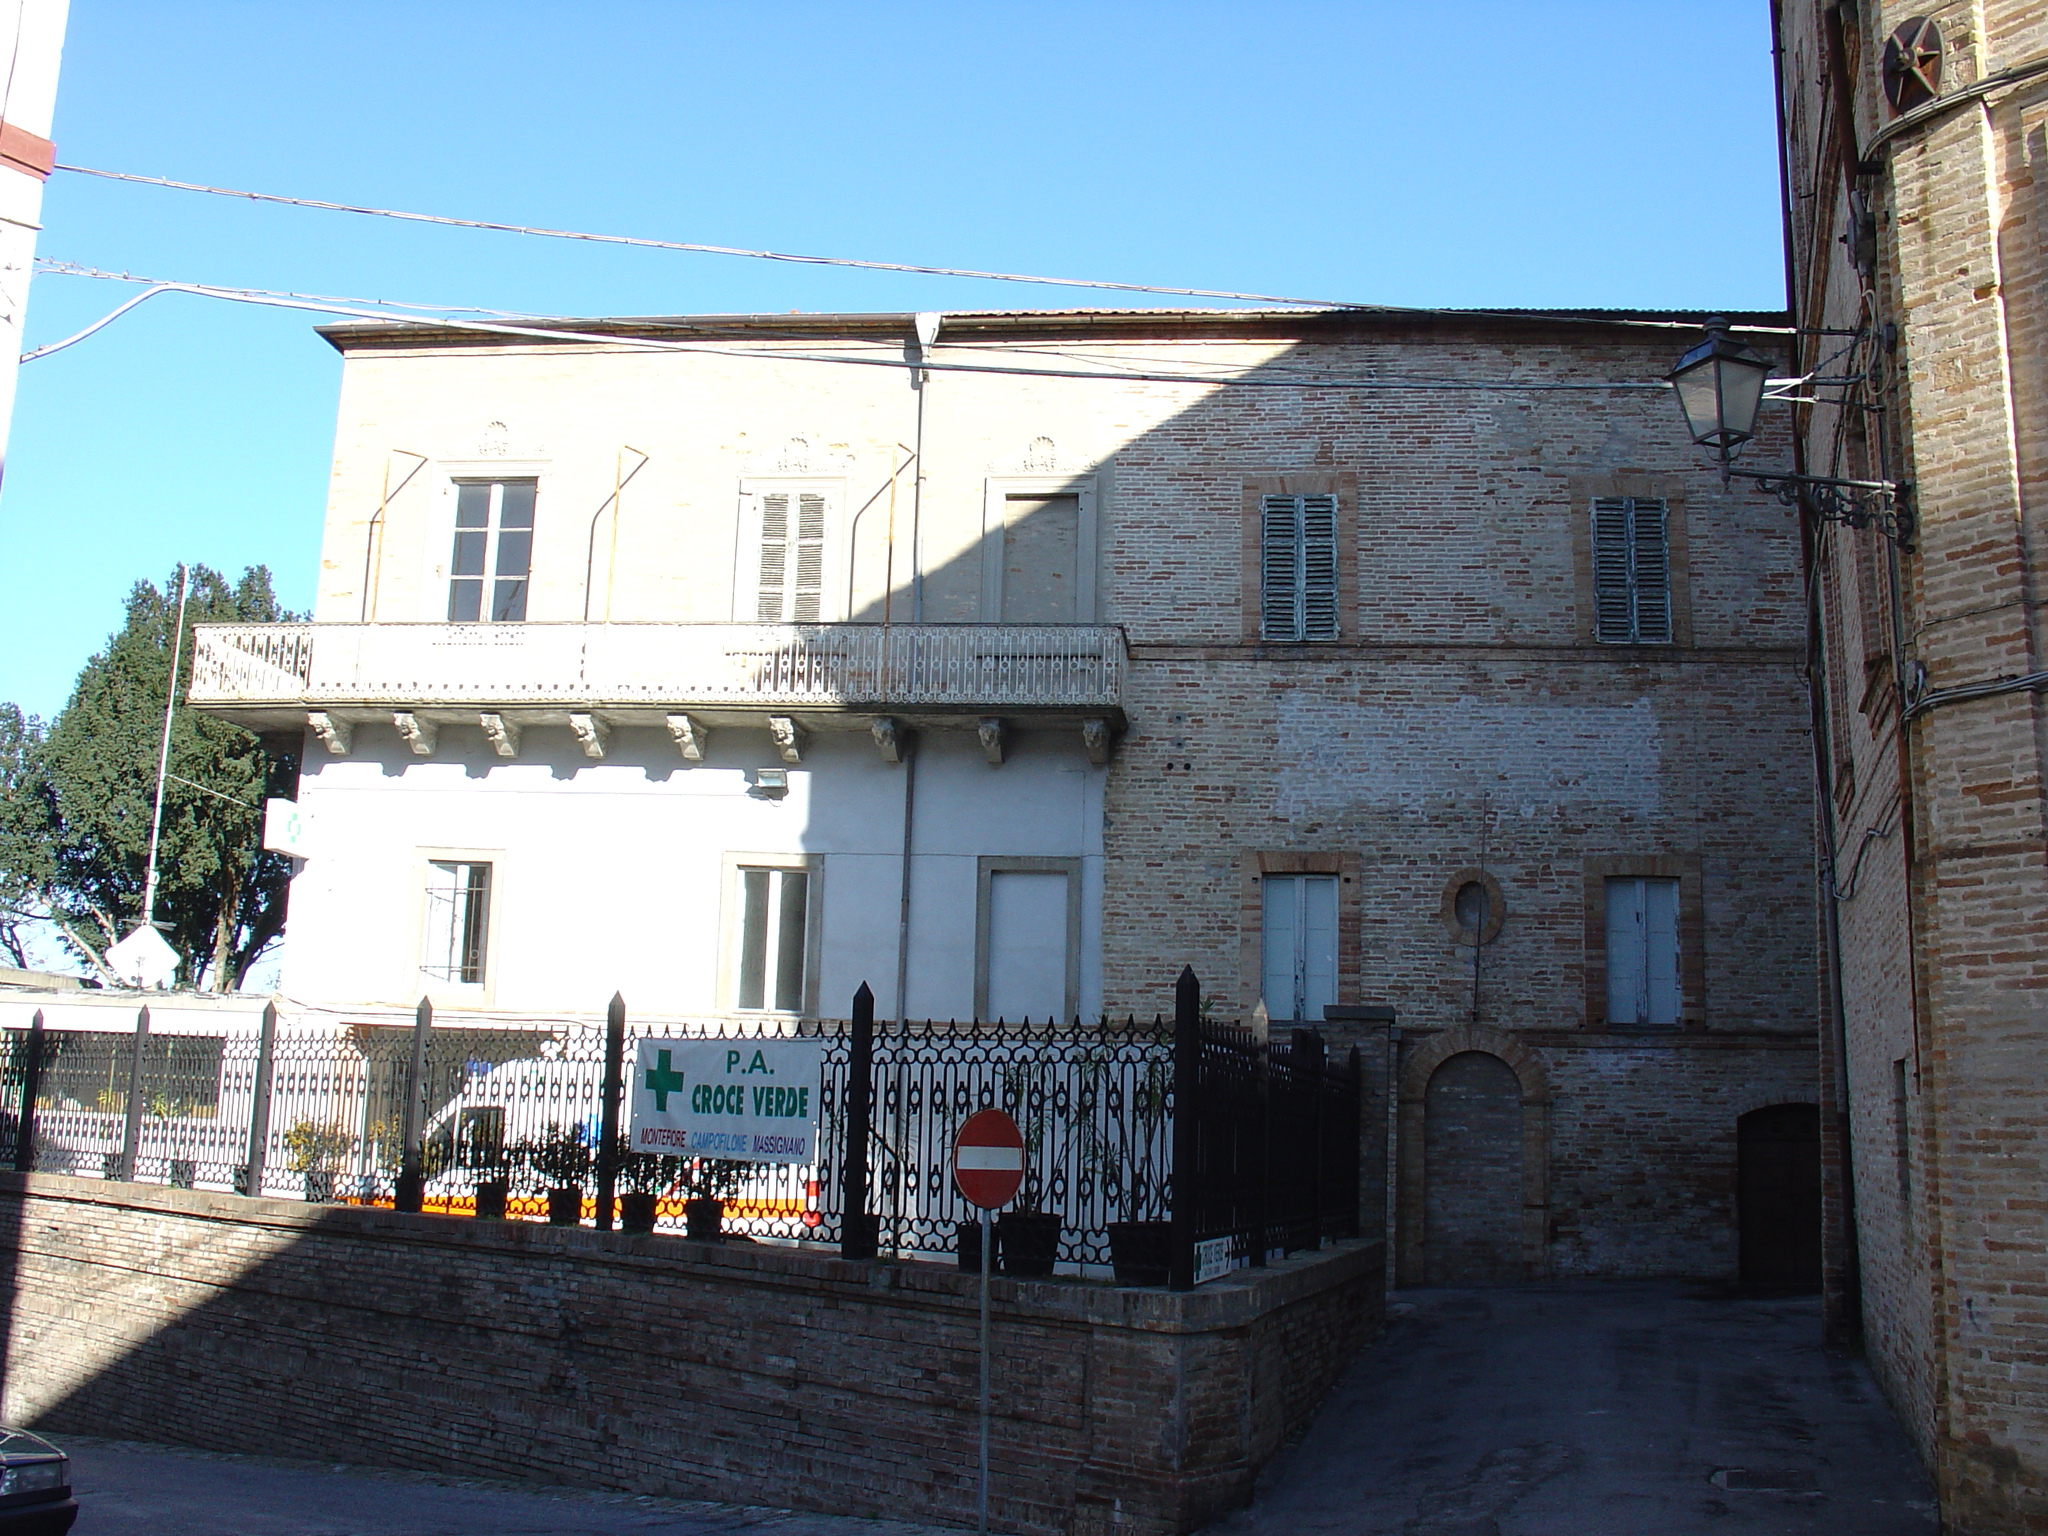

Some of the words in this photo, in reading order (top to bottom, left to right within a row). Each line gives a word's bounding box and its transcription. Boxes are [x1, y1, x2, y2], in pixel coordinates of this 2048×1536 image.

[726, 1050, 775, 1075] P.A.
[691, 1084, 744, 1115] CROCE
[752, 1086, 809, 1118] VERDE
[640, 1128, 687, 1148] MONTEFIORE
[690, 1133, 747, 1152] CAMPOFILONE
[752, 1135, 806, 1156] MASSIGNANO
